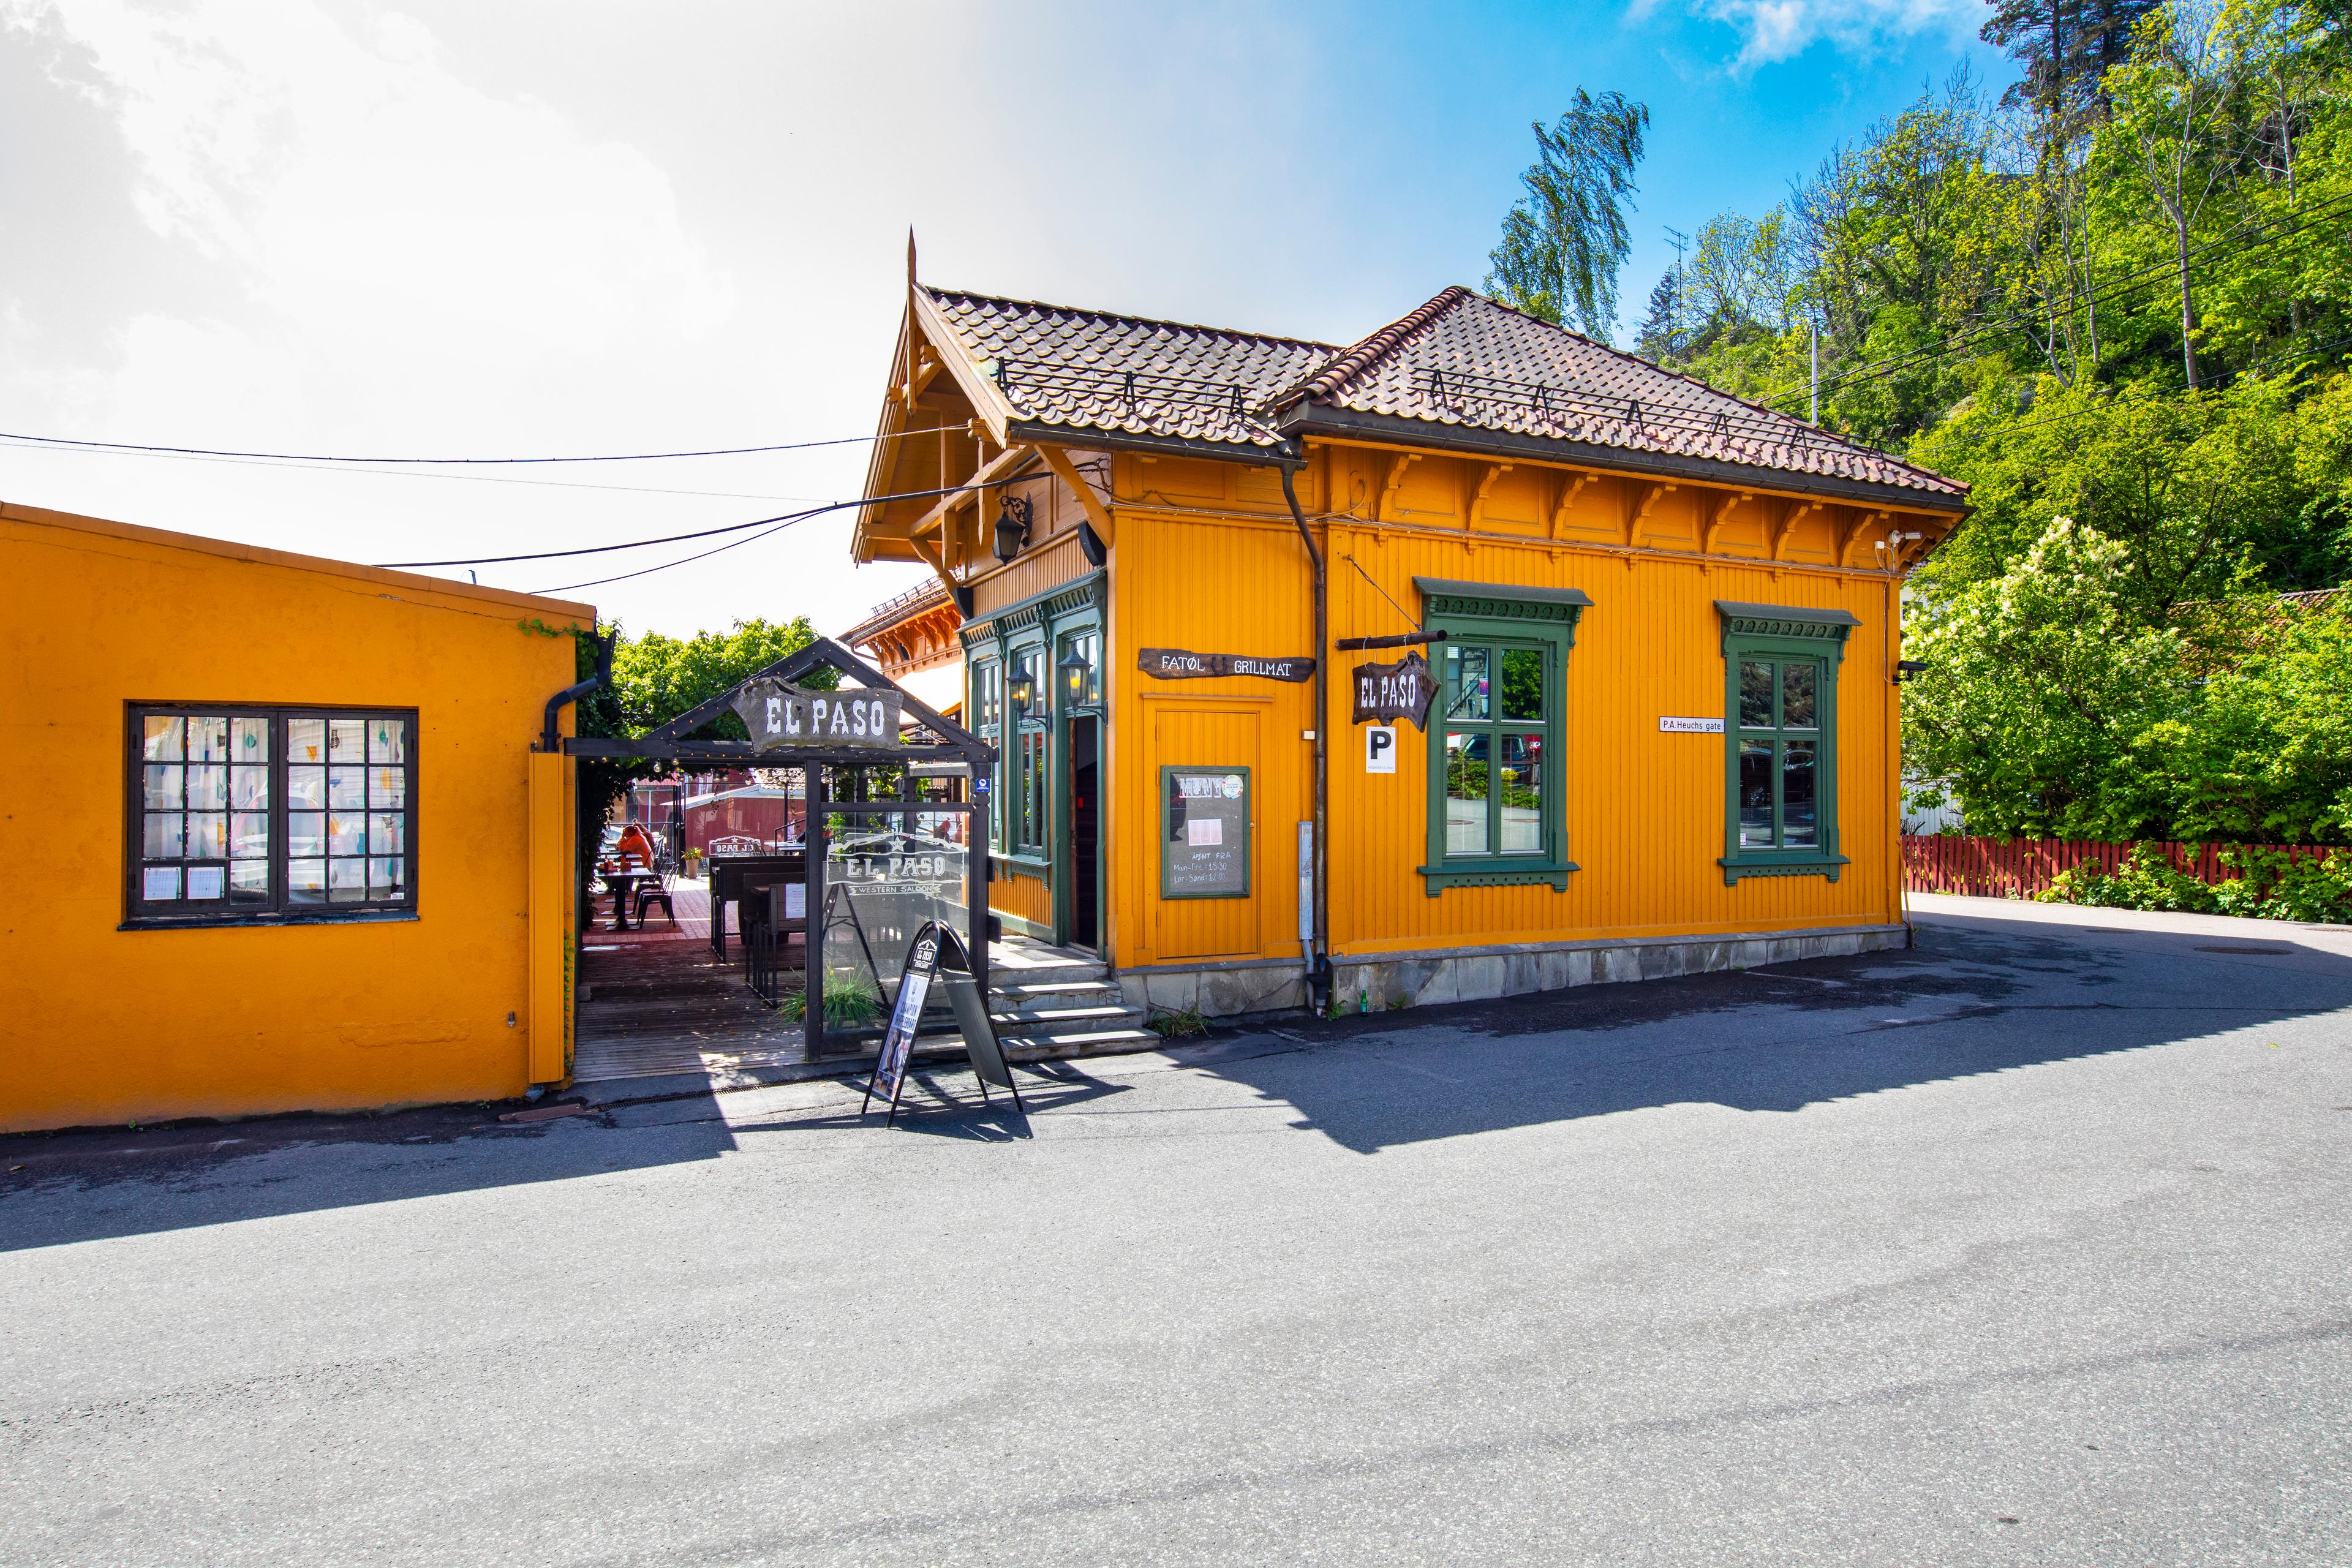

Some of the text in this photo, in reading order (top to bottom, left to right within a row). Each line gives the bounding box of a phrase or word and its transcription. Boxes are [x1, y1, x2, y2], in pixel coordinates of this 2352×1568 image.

[1161, 655, 1292, 676] FATØL GRILLMAT
[1361, 674, 1416, 708] EL PASO
[766, 696, 885, 736] EL PASO
[1706, 723, 1721, 731] gate
[1371, 731, 1392, 760] P
[846, 857, 946, 878] EL PASO
